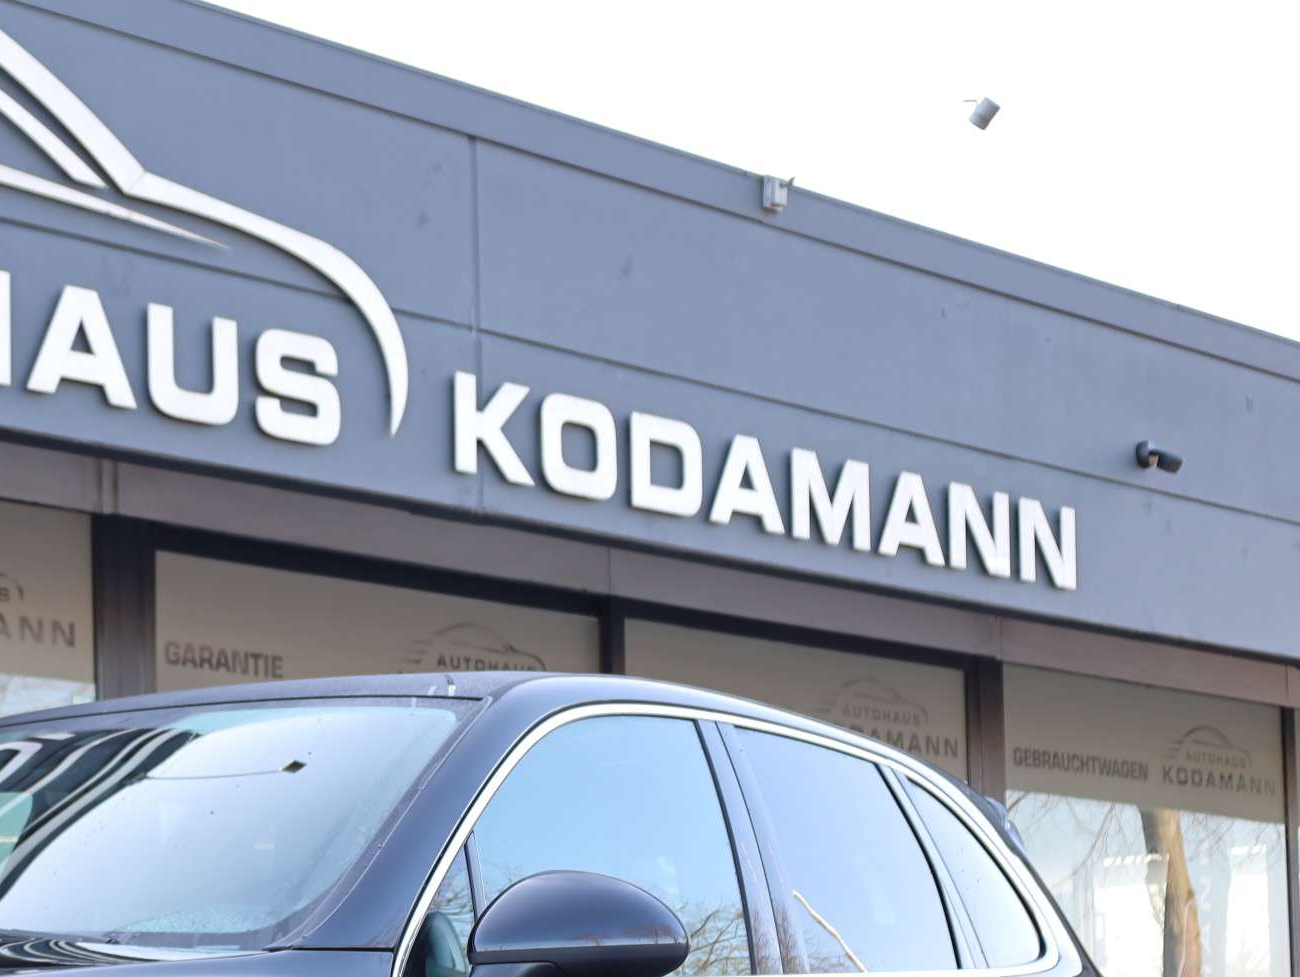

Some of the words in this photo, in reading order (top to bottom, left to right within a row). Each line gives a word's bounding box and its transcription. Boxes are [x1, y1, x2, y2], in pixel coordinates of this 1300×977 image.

[454, 370, 1077, 590] KODAMANN
[163, 640, 284, 680] GARANTIE
[843, 703, 922, 727] AUTOHAUS
[1012, 746, 1149, 782] GEBRAUCHTWAGEN
[1184, 750, 1247, 770] AUTOHAUS
[1162, 765, 1277, 797] KODAMANN
